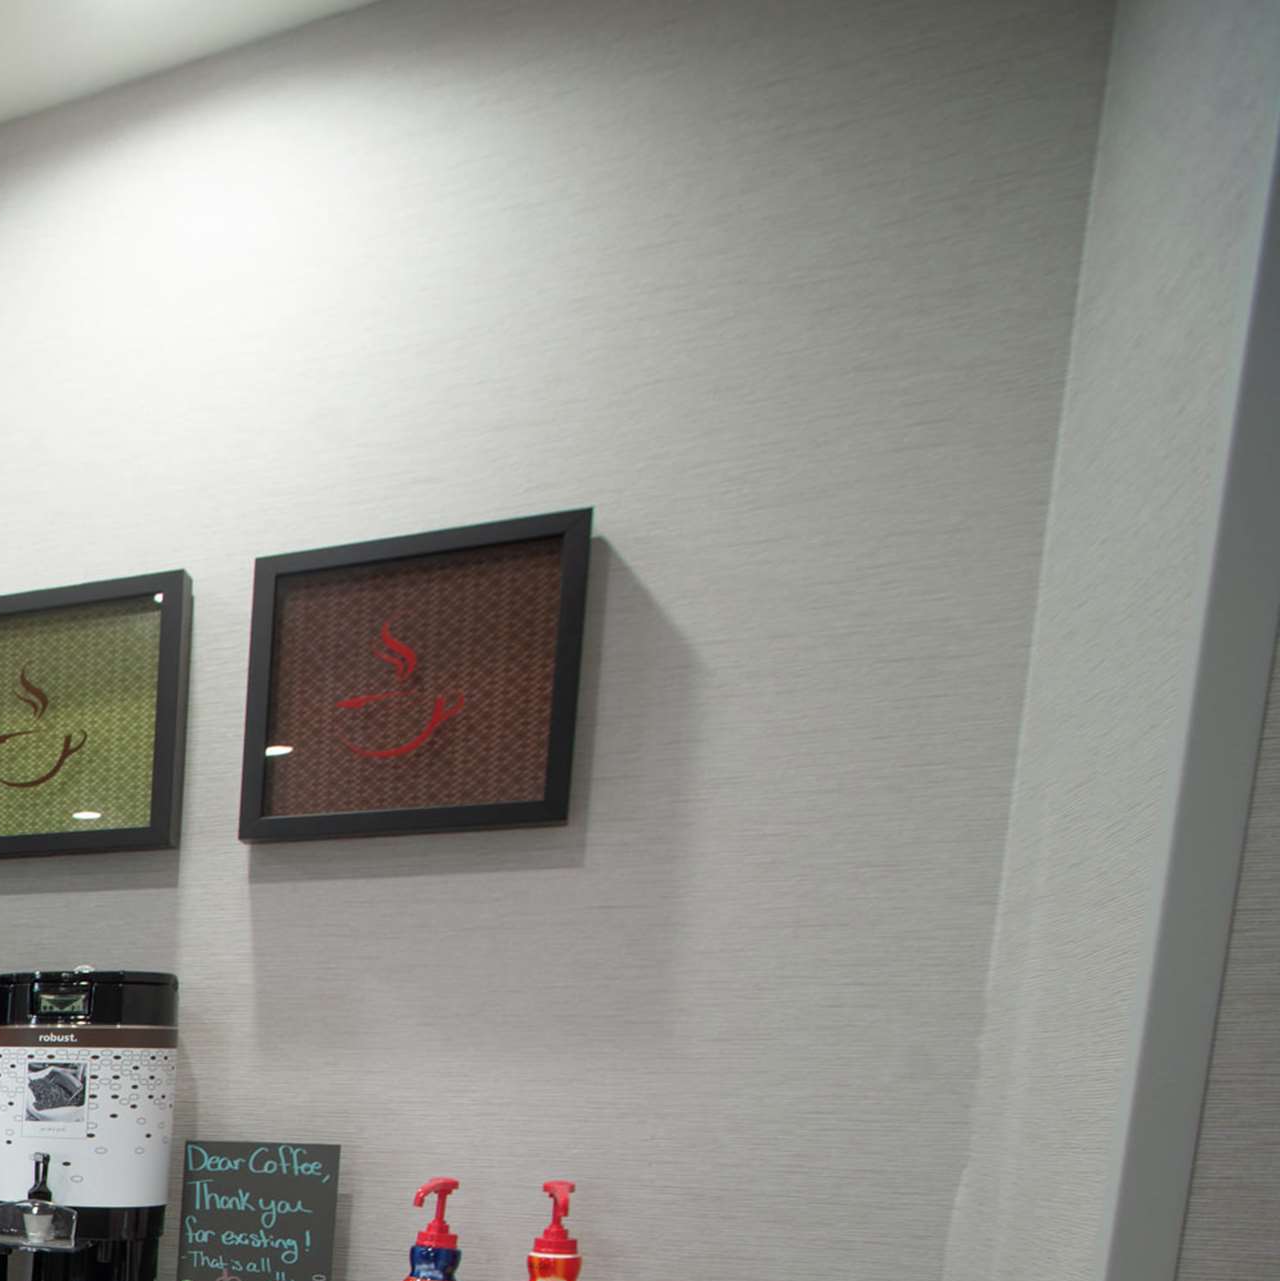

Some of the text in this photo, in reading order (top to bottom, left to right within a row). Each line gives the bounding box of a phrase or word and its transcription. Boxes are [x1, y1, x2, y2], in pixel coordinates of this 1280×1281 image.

[39, 1032, 78, 1042] robust.
[187, 1144, 245, 1171] Dear
[187, 1179, 313, 1229] Thank you
[184, 1215, 215, 1243] for
[246, 1257, 272, 1273] all
